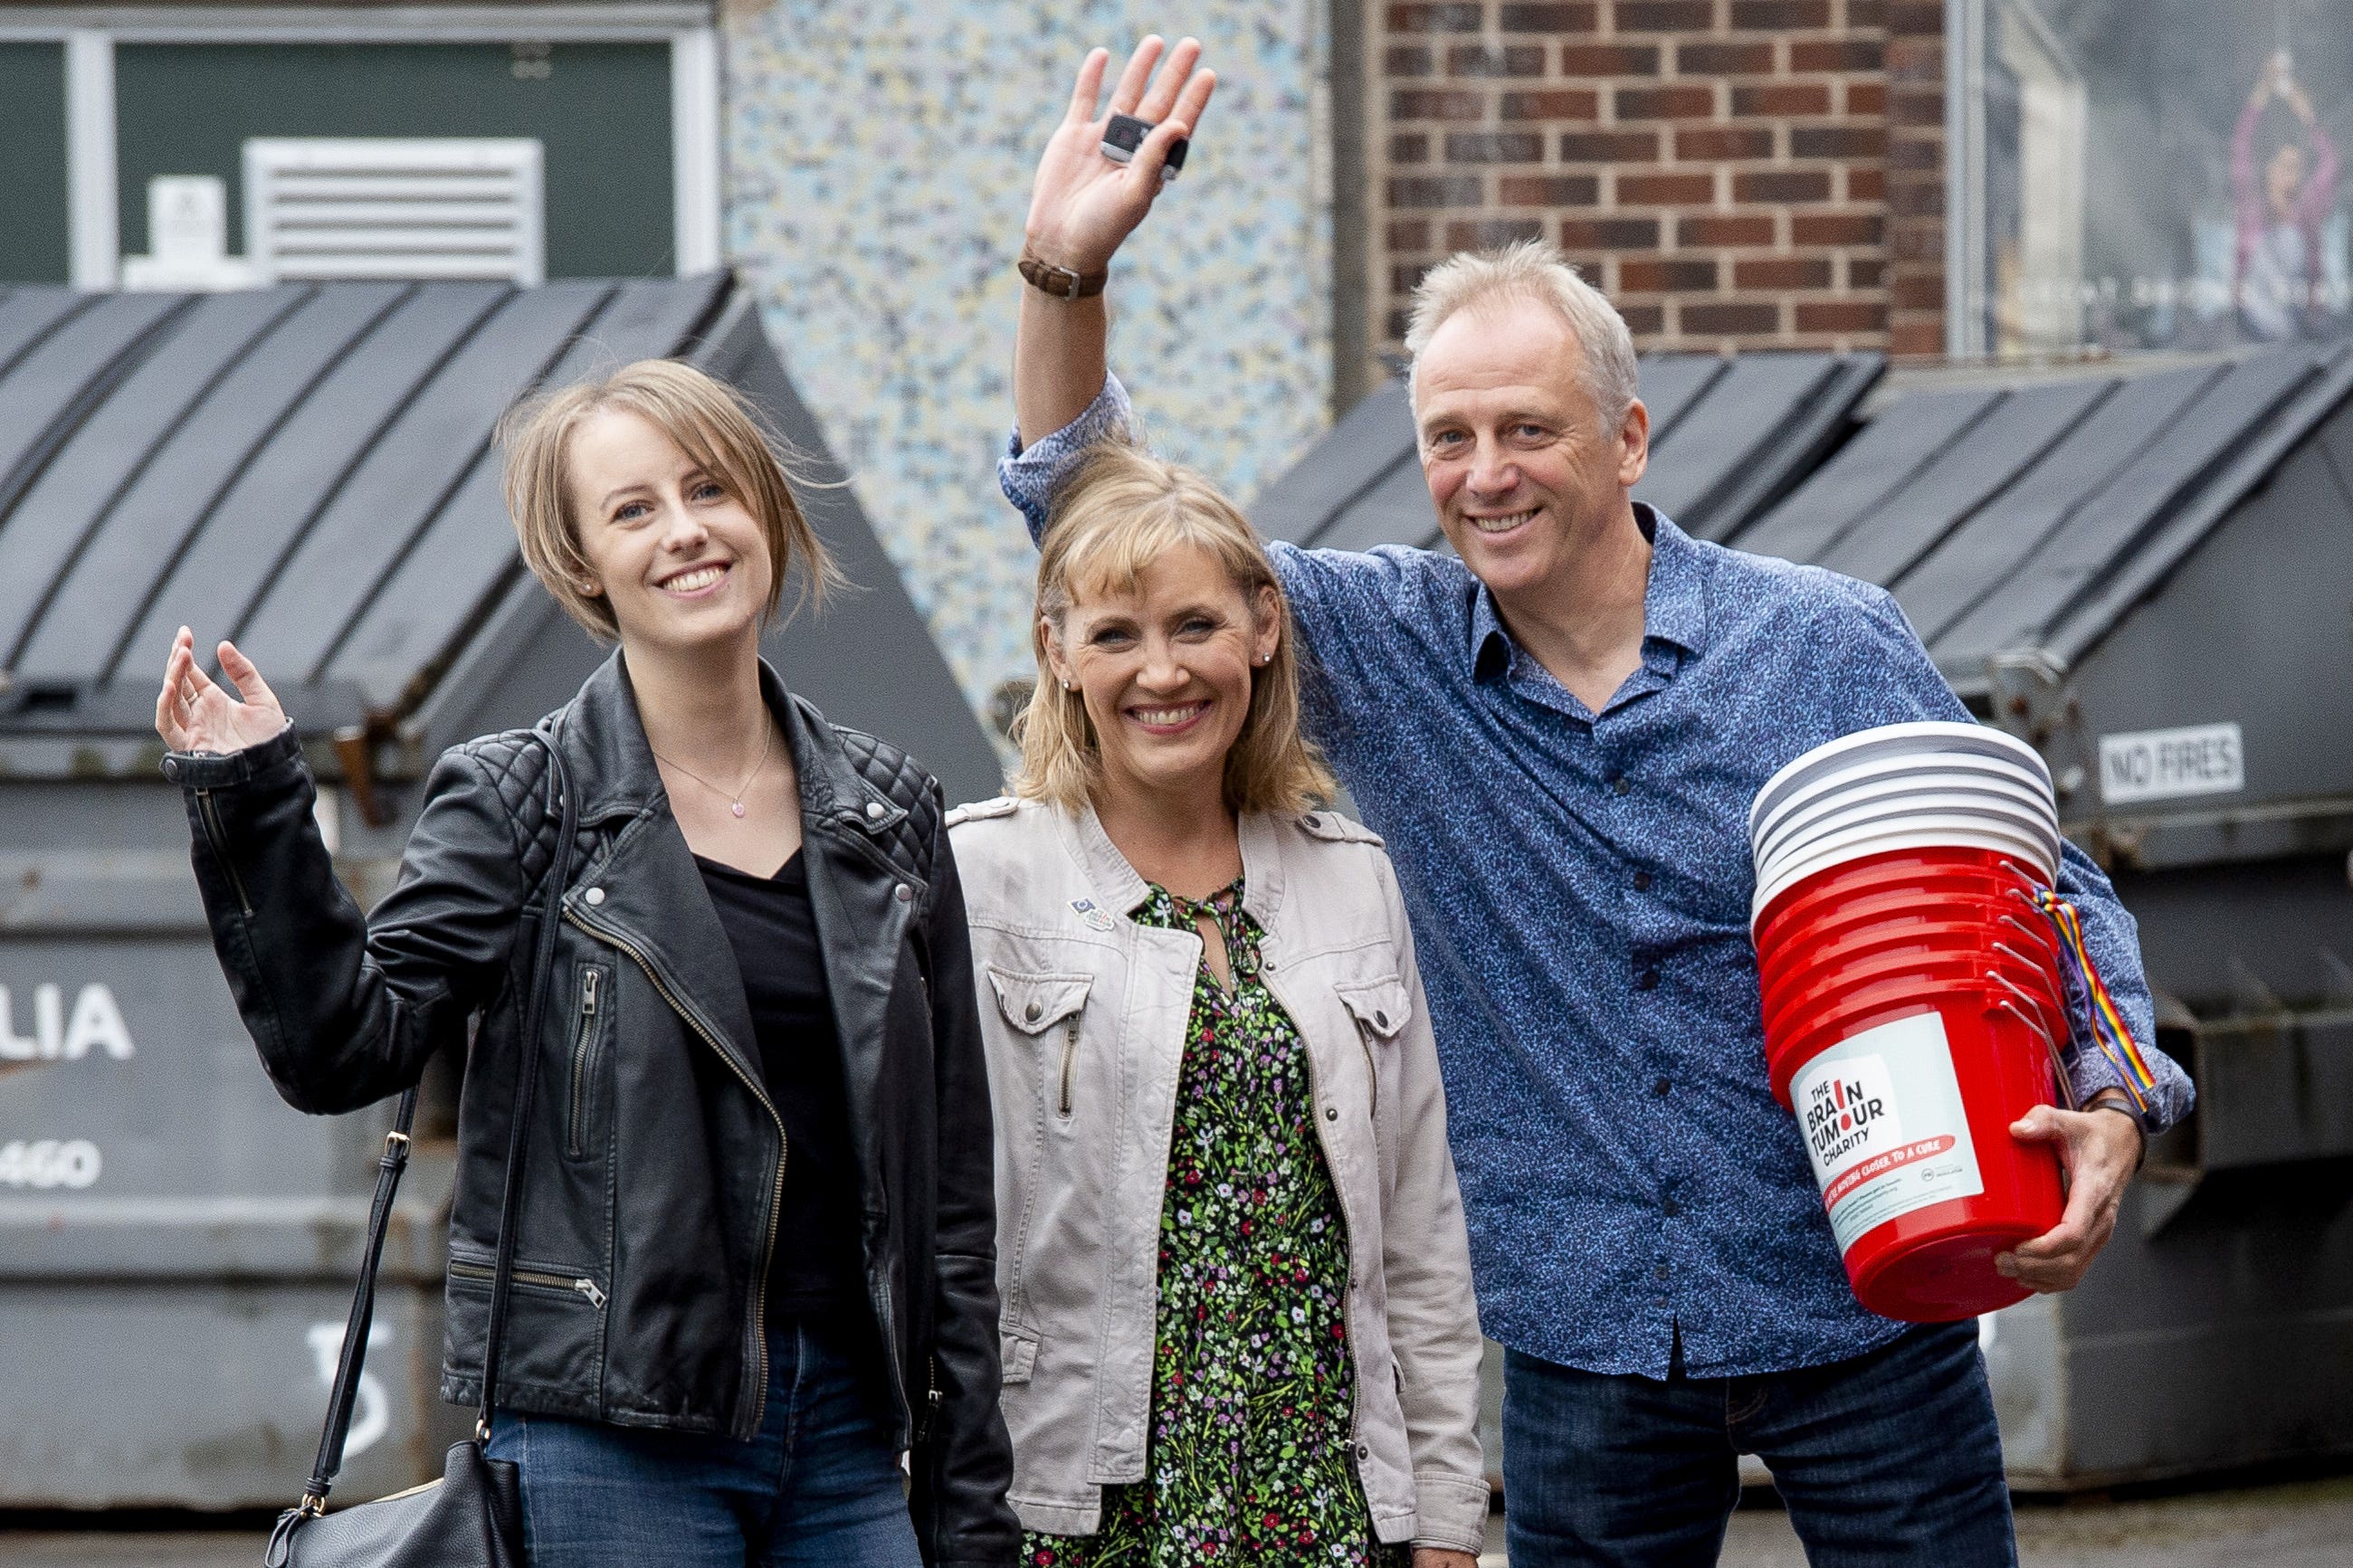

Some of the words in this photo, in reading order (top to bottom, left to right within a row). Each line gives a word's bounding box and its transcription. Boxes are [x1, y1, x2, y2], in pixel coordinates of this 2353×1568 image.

[2110, 746, 2153, 786] NO
[2158, 737, 2237, 784] FIRES
[1811, 1080, 1830, 1103] THE
[1811, 1098, 1885, 1157] TUMOUR
[1823, 1126, 1870, 1167] CHARITY
[1891, 1150, 1906, 1164] TO
[1907, 1146, 1915, 1159] A
